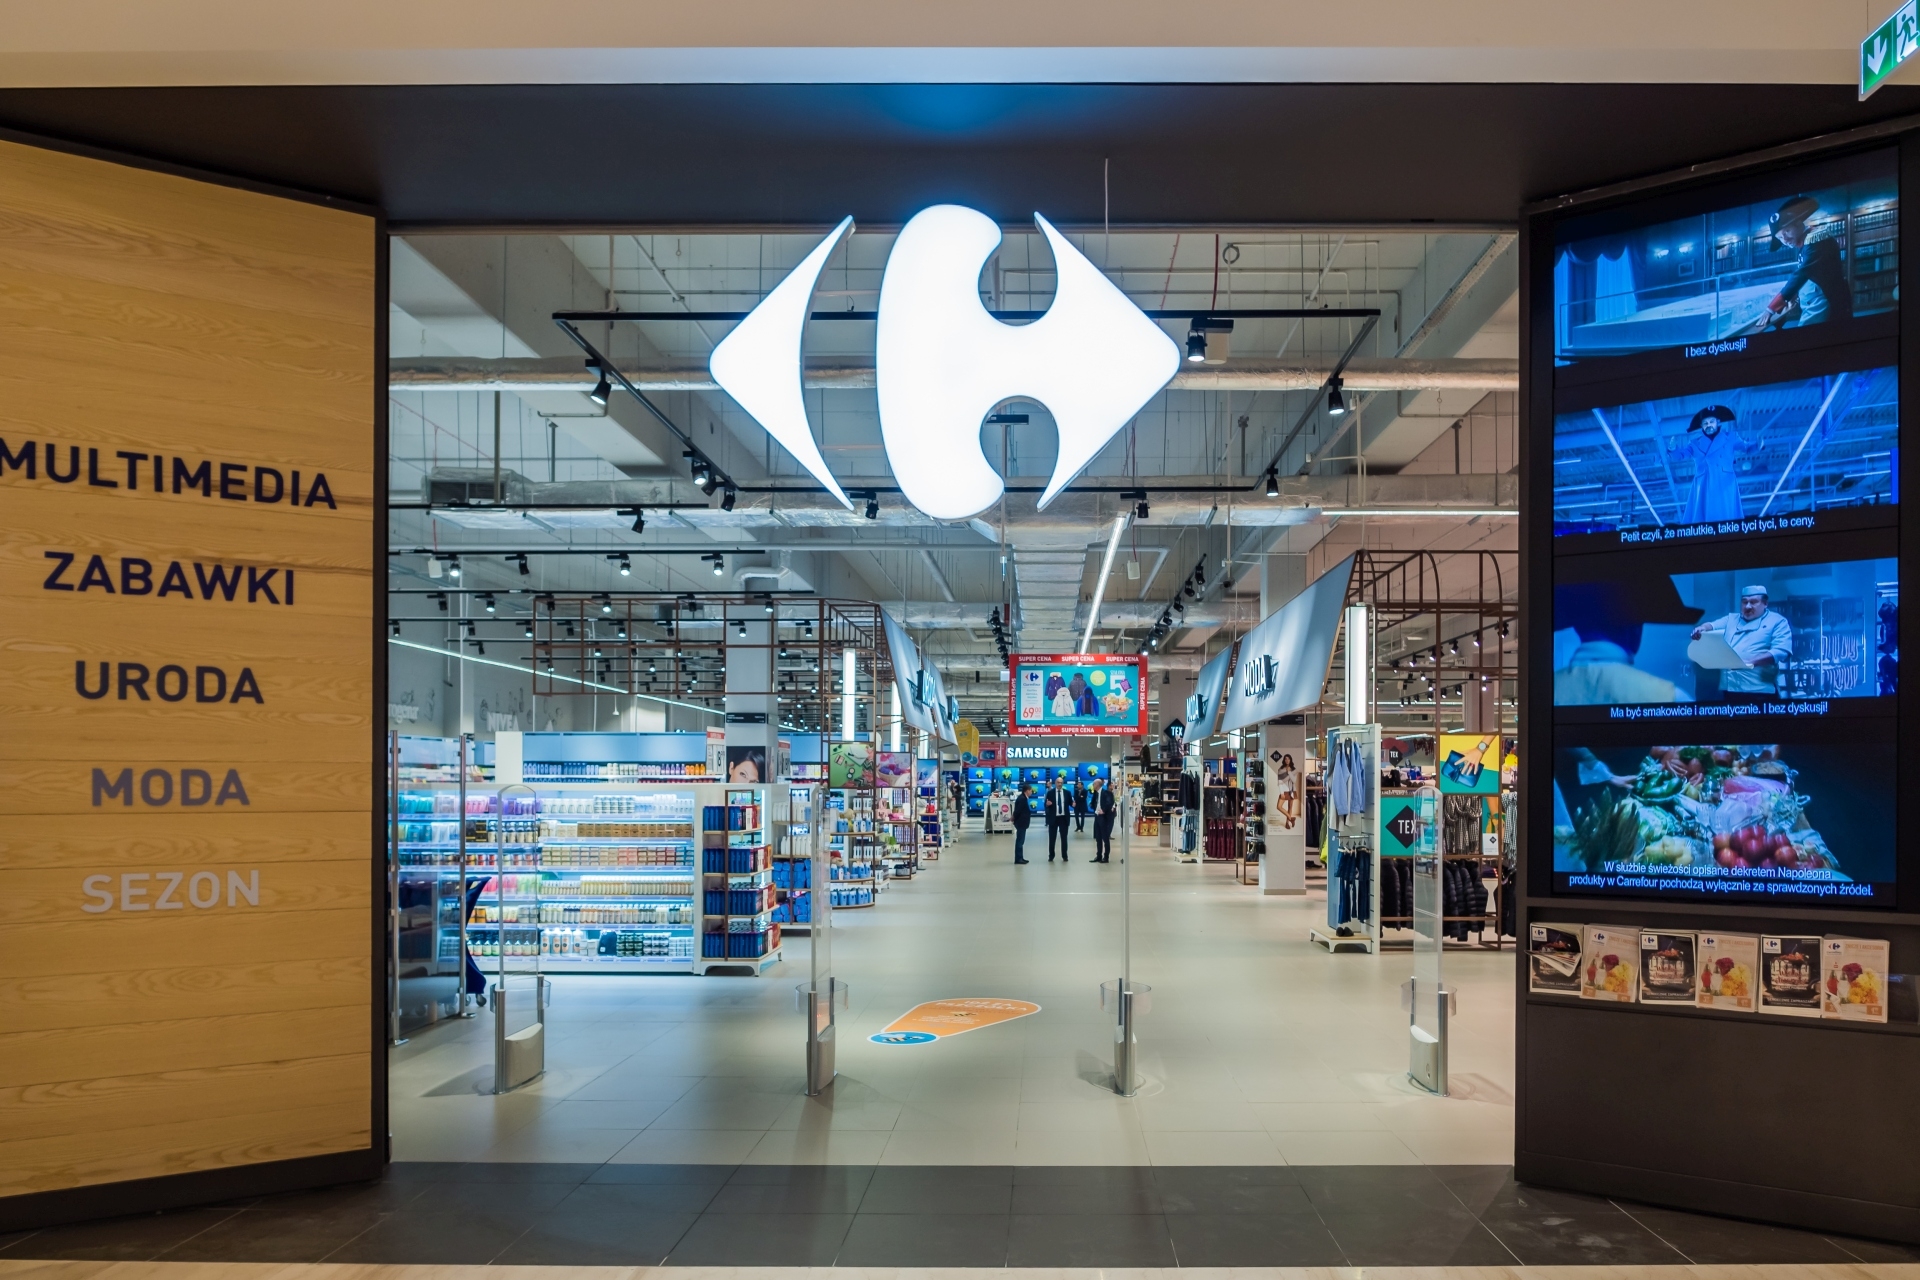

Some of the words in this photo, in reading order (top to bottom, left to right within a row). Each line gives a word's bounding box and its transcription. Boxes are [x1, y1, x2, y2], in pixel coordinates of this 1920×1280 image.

[1685, 347, 1689, 358] I
[1690, 346, 1707, 357] bez
[1708, 338, 1747, 356] dyskusji!
[0, 437, 337, 510] MULTIMEDIA
[1641, 530, 1662, 542] czyli,
[1664, 527, 1675, 539] że
[1676, 524, 1716, 538] malutkie,
[1718, 522, 1739, 534] takie
[1741, 520, 1757, 533] tyci
[1758, 518, 1777, 532] tyci,
[1779, 518, 1788, 528] te
[1790, 516, 1815, 530] ceny.
[44, 551, 294, 605] ZABAWKI
[75, 660, 265, 704] URODA
[1244, 654, 1266, 696] MODA
[486, 711, 520, 732] NIVEA
[1610, 707, 1624, 718] Ma
[1626, 706, 1641, 719] być
[1642, 705, 1692, 716] smakowicie
[1694, 705, 1697, 716] i
[1699, 704, 1761, 718] aromatycznie.
[1764, 703, 1766, 714] I
[1768, 703, 1786, 714] bez
[1788, 702, 1828, 715] dyskusji!
[1171, 727, 1183, 736] TEX
[1007, 747, 1068, 758] SAMSUNG
[91, 768, 250, 807] MODA
[1398, 820, 1416, 834] TEX
[1604, 861, 1615, 872] W
[1616, 862, 1646, 873] służbie
[1648, 862, 1690, 874] świeżości
[1692, 865, 1728, 877] opisane
[1731, 866, 1776, 877] dekretem
[1778, 866, 1832, 880] Napoleona
[80, 870, 260, 913] SEZON
[1569, 874, 1605, 888] produkty
[1607, 877, 1615, 886] w
[1617, 875, 1658, 888] Carrefour
[1660, 878, 1705, 892] pochodzą
[1706, 880, 1751, 892] wyłącznie
[1753, 883, 1765, 892] ze
[1766, 882, 1838, 896] sprawdzonych
[1839, 883, 1874, 896] źródeł.
